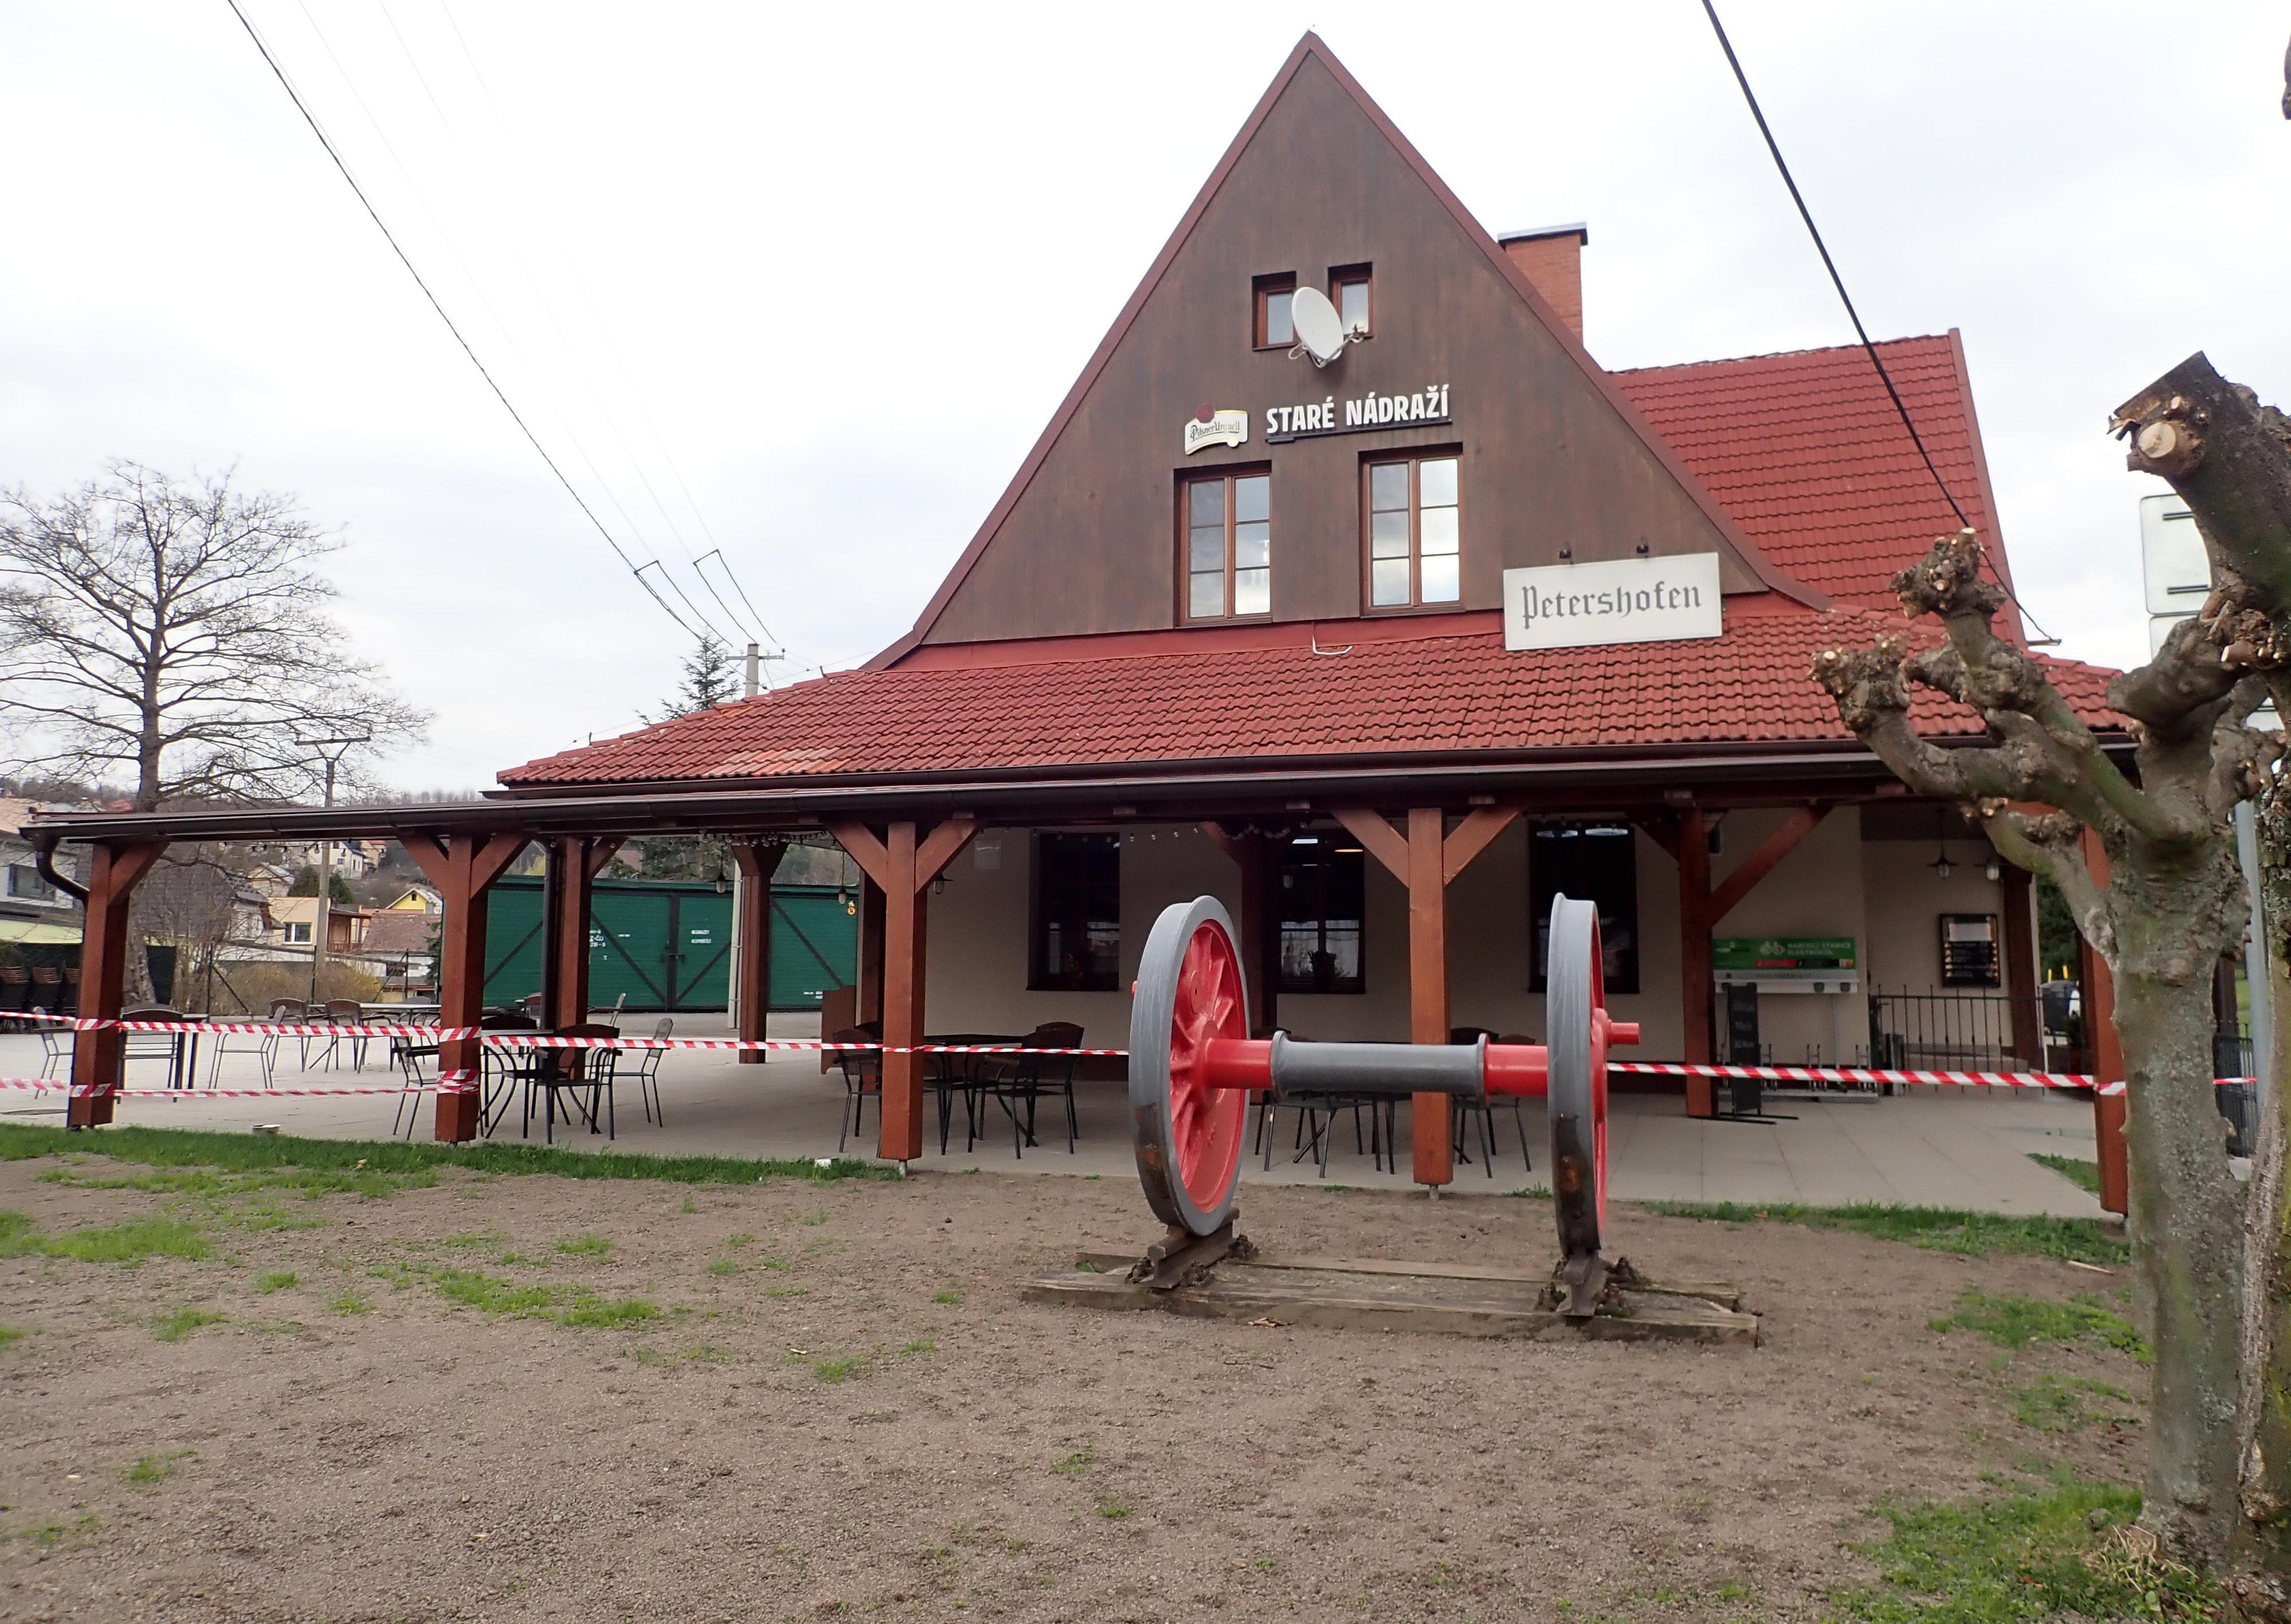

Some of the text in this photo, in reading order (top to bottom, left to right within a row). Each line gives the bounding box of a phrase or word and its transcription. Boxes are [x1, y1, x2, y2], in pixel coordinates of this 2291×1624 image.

[1190, 424, 1215, 442] Pilsner
[1266, 384, 1450, 434] STARÉ NÁDRAŽÍ
[1521, 581, 1702, 630] Petershofen
